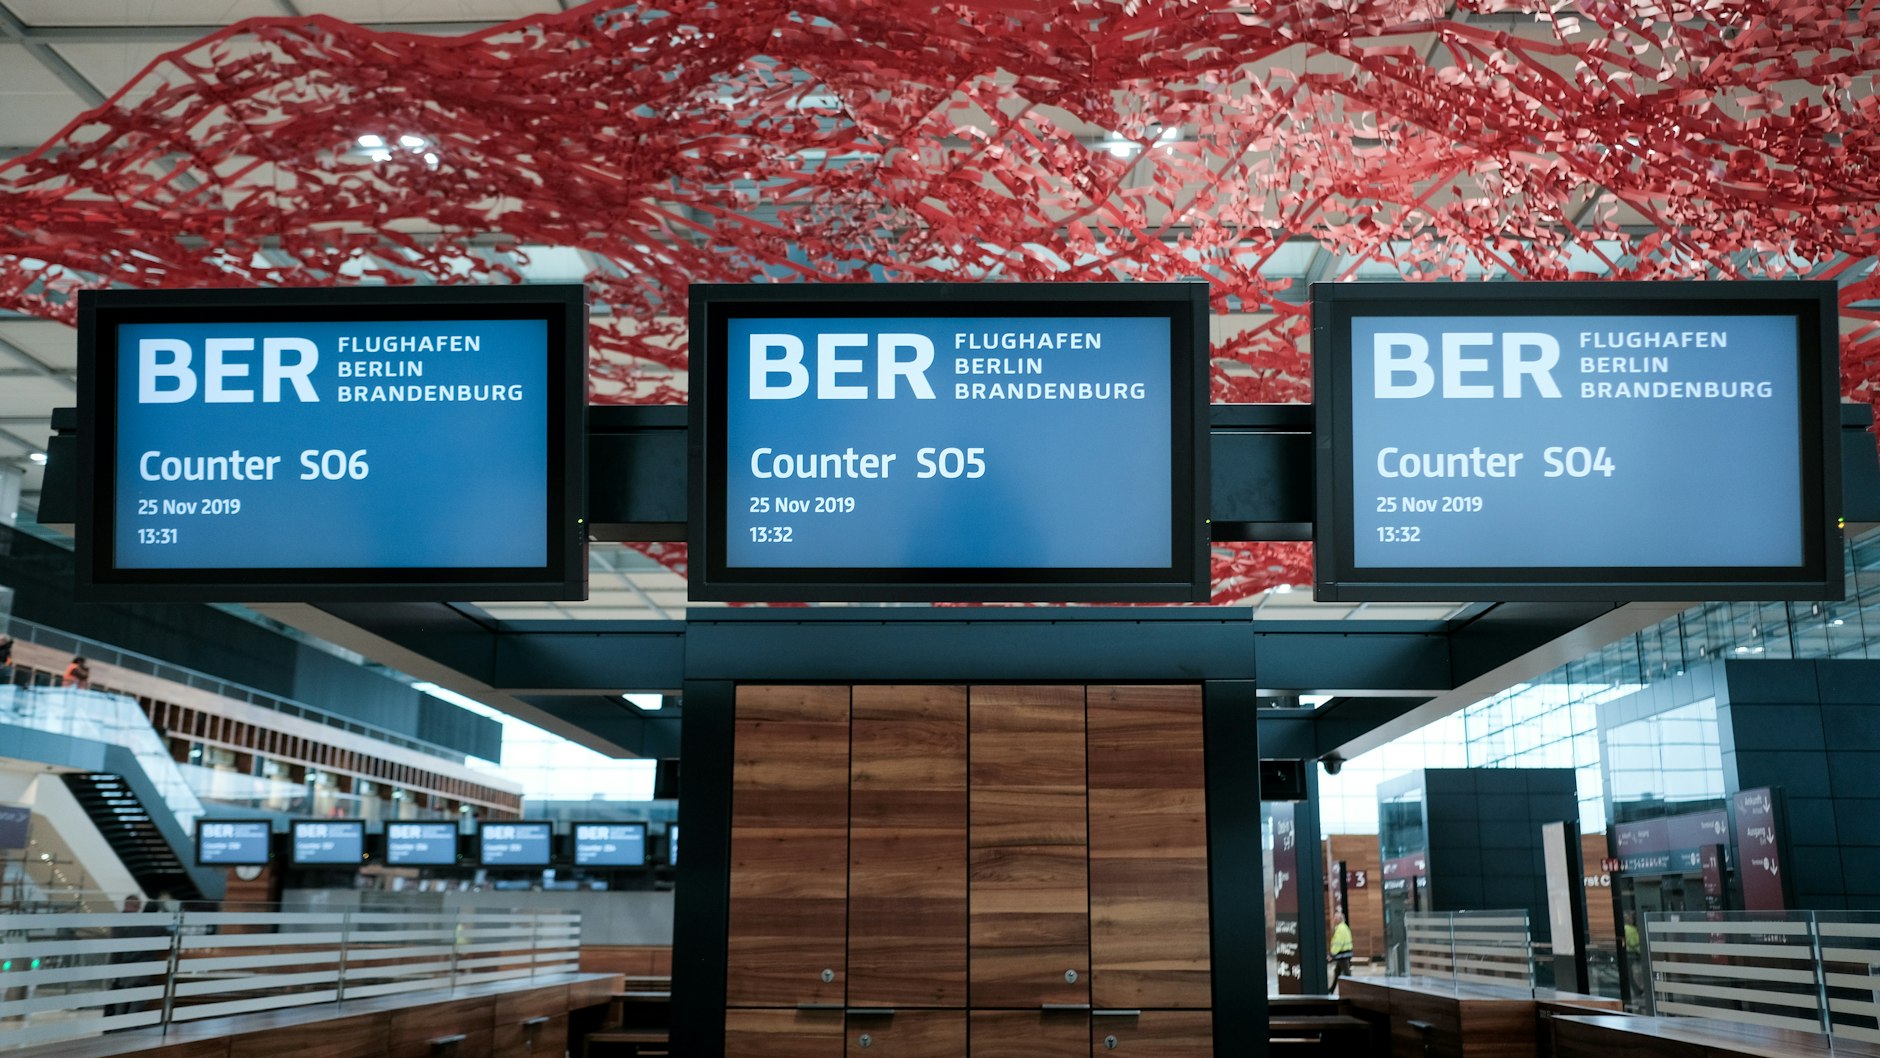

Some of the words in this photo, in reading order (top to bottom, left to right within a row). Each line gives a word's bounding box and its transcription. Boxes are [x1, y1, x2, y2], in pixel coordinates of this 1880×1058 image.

[339, 336, 479, 352] FLUGHAFEN
[956, 333, 1100, 349] FLUGHAFEN
[1580, 332, 1726, 348] FLUGHAFEN
[139, 338, 319, 403] BER
[339, 361, 422, 377] BERLIN
[750, 334, 936, 399] BER
[956, 358, 1041, 374] BERLIN
[1374, 333, 1562, 398] BER
[1581, 357, 1667, 372] BERLIN
[338, 385, 522, 402] BRANDENBURG
[956, 383, 1144, 399] BRANDENBURG
[1581, 382, 1771, 398] BRANDENBURG
[140, 450, 280, 480] Counter
[752, 448, 896, 478] Counter
[1378, 447, 1523, 477] Counter
[139, 500, 158, 514] 25
[164, 500, 197, 514] Nov
[202, 499, 240, 514] 2019
[750, 497, 769, 512] 25
[776, 498, 810, 512] Nov
[815, 497, 855, 512] 2019
[1377, 497, 1396, 512] 25
[1403, 497, 1437, 512] Nov
[1442, 497, 1482, 512] 2019
[138, 529, 177, 543] 13:31
[750, 527, 792, 542] 13:32
[1377, 527, 1420, 542] 13:32
[1356, 871, 1366, 888] 3
